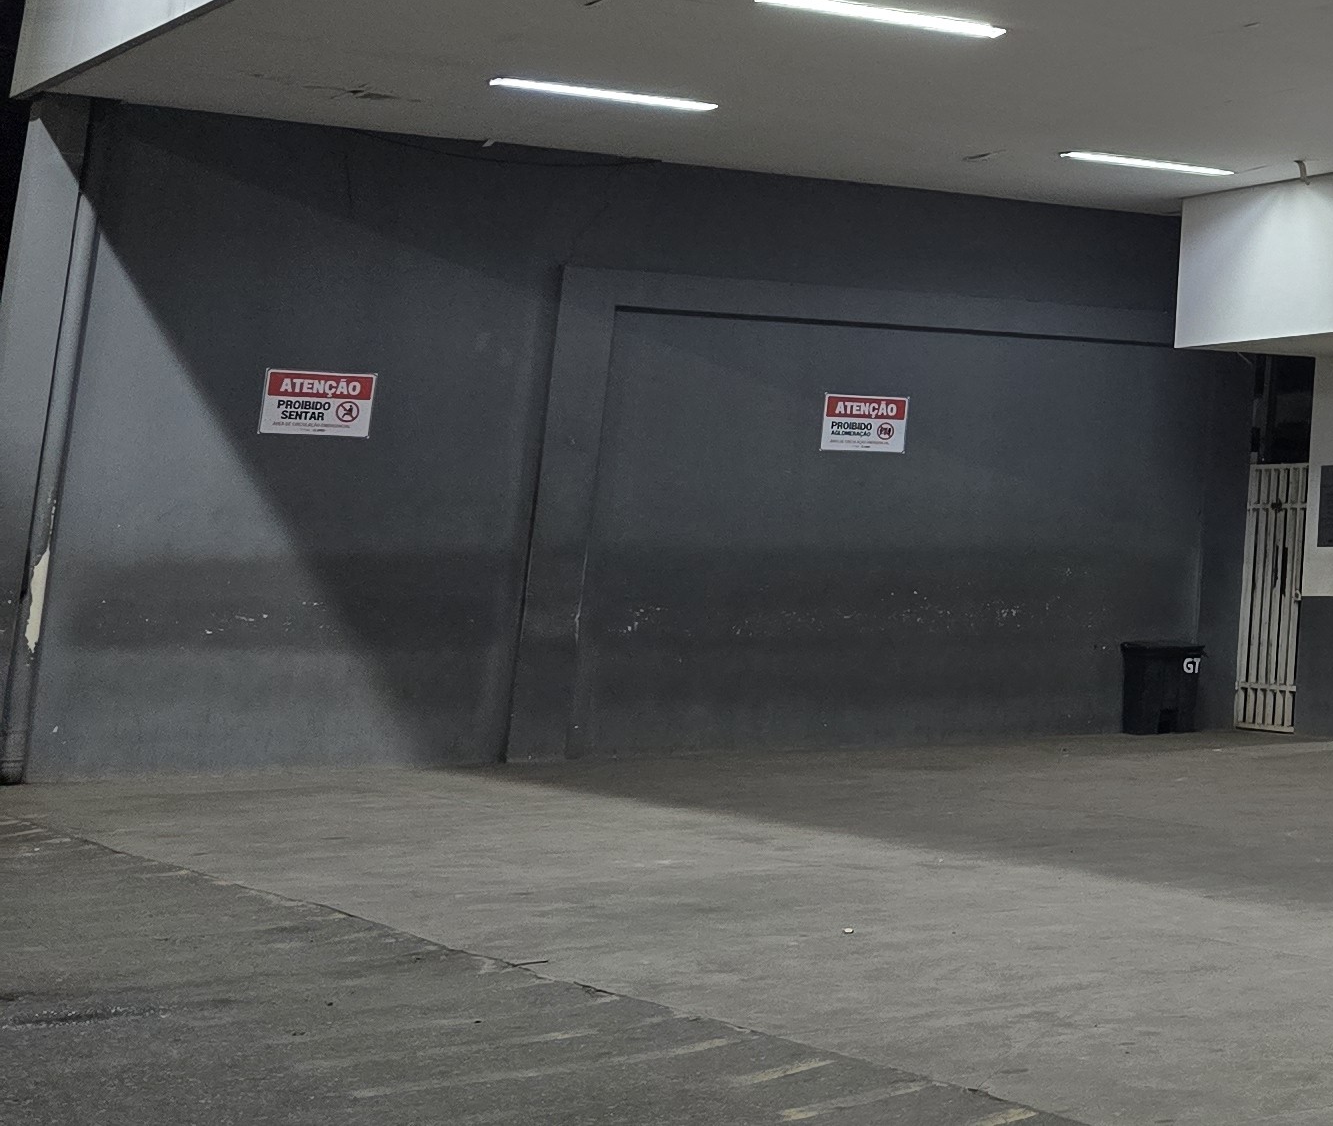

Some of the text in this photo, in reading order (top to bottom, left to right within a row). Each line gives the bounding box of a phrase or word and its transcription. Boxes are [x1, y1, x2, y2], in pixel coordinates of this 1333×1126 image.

[279, 377, 362, 398] ATENÇÃO
[277, 399, 331, 411] PROIBIDO
[834, 400, 897, 419] ATENÇÃO
[280, 410, 325, 421] SENTAR
[830, 420, 873, 431] PROIBIDO
[1182, 657, 1201, 674] GT
